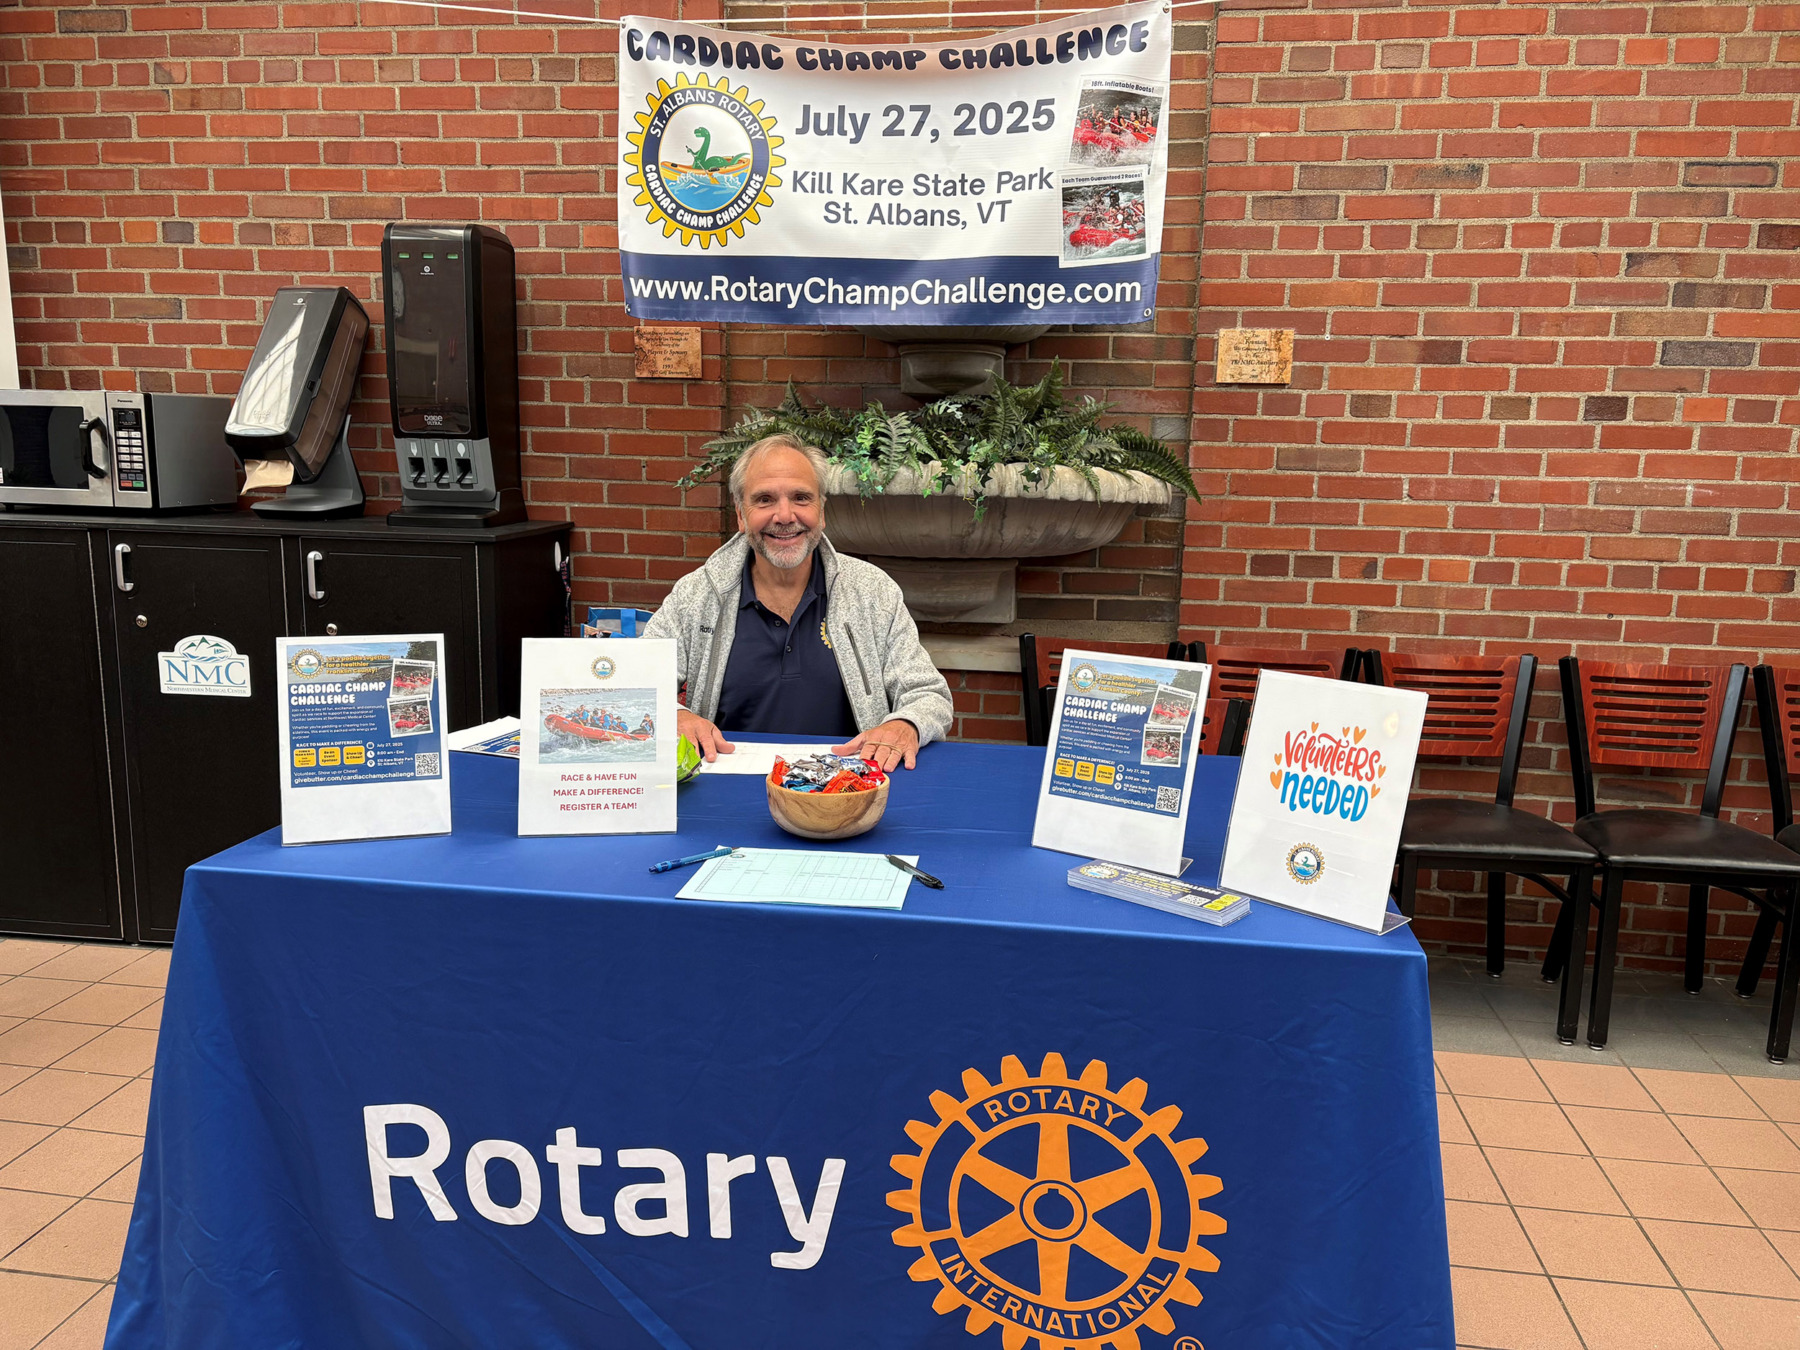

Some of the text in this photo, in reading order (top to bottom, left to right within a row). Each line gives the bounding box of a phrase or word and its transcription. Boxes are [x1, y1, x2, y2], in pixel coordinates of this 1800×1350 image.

[626, 20, 1149, 71] CARDIAC CHAMP CHALLENGE
[1104, 80, 1135, 90] Inflatable
[1135, 84, 1155, 94] Boats!
[650, 90, 765, 141] ST. ALBANS ROTARY
[795, 98, 1056, 144] July 27, 2025
[792, 167, 1054, 197] Kill Kare State Park
[1090, 174, 1121, 182] Guaranteed
[645, 164, 764, 228] CARDIAC CHAMP CHALLENGE
[823, 199, 1012, 230] St. Albans, VT
[629, 275, 1142, 311] www.RotaryChampChallenge.com
[164, 659, 246, 686] NMC
[290, 681, 386, 694] CARDIAC CHAMP
[290, 694, 356, 706] CHALLENGE
[1063, 707, 1118, 723] CHALLENGE
[1065, 696, 1147, 715] CARDIAC CHAMP
[294, 771, 414, 784] givebutter.com/cardiacchampchallenge
[587, 787, 644, 796] DIFFERENCE!
[1052, 786, 1154, 809] givebutter.com/cardiacchampchallenge
[560, 803, 602, 811] REGISTER
[611, 802, 637, 810] TEAM!
[983, 1088, 1127, 1127] ROTARY
[363, 1103, 846, 1270] Rotary
[940, 1252, 1173, 1337] INTERNATIONAL
